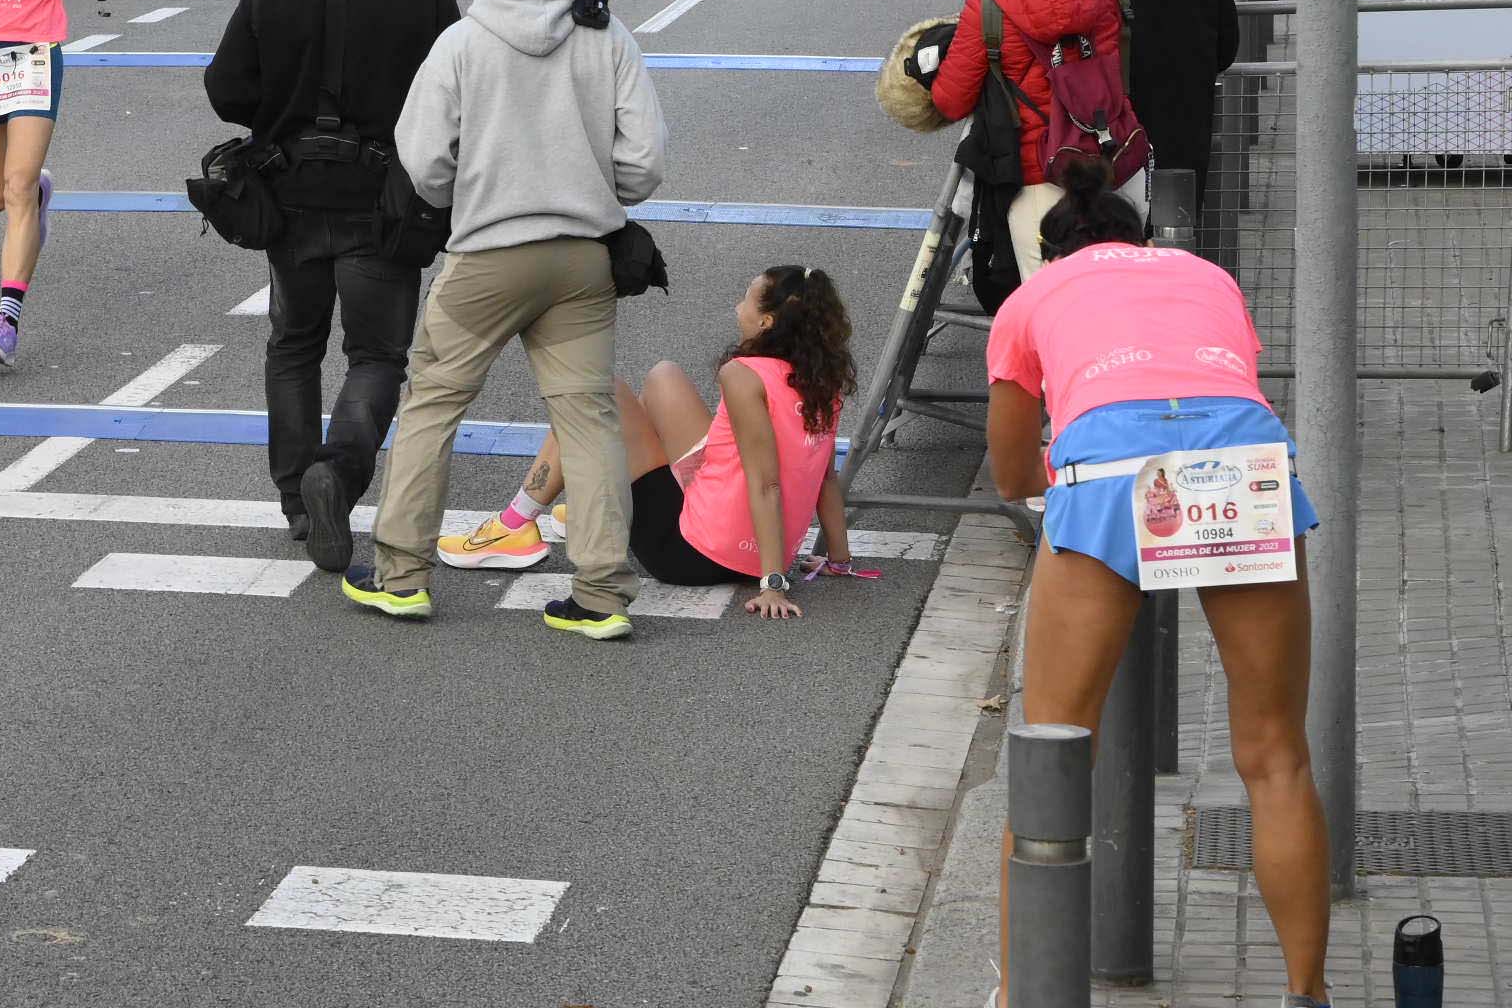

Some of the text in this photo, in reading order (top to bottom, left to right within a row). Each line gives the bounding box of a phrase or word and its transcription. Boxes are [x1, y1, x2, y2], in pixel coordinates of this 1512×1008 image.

[2, 70, 24, 82] 016
[1085, 350, 1152, 379] OYSHO
[1247, 462, 1276, 472] SUMA
[1188, 501, 1238, 523] 016
[1195, 527, 1234, 541] 10984
[1155, 548, 1198, 558] CARRERA
[1199, 547, 1212, 555] DE
[1213, 546, 1224, 554] LA
[1226, 543, 1256, 553] MUJER
[1153, 566, 1200, 579] OYSHO
[1237, 561, 1284, 573] Santander
